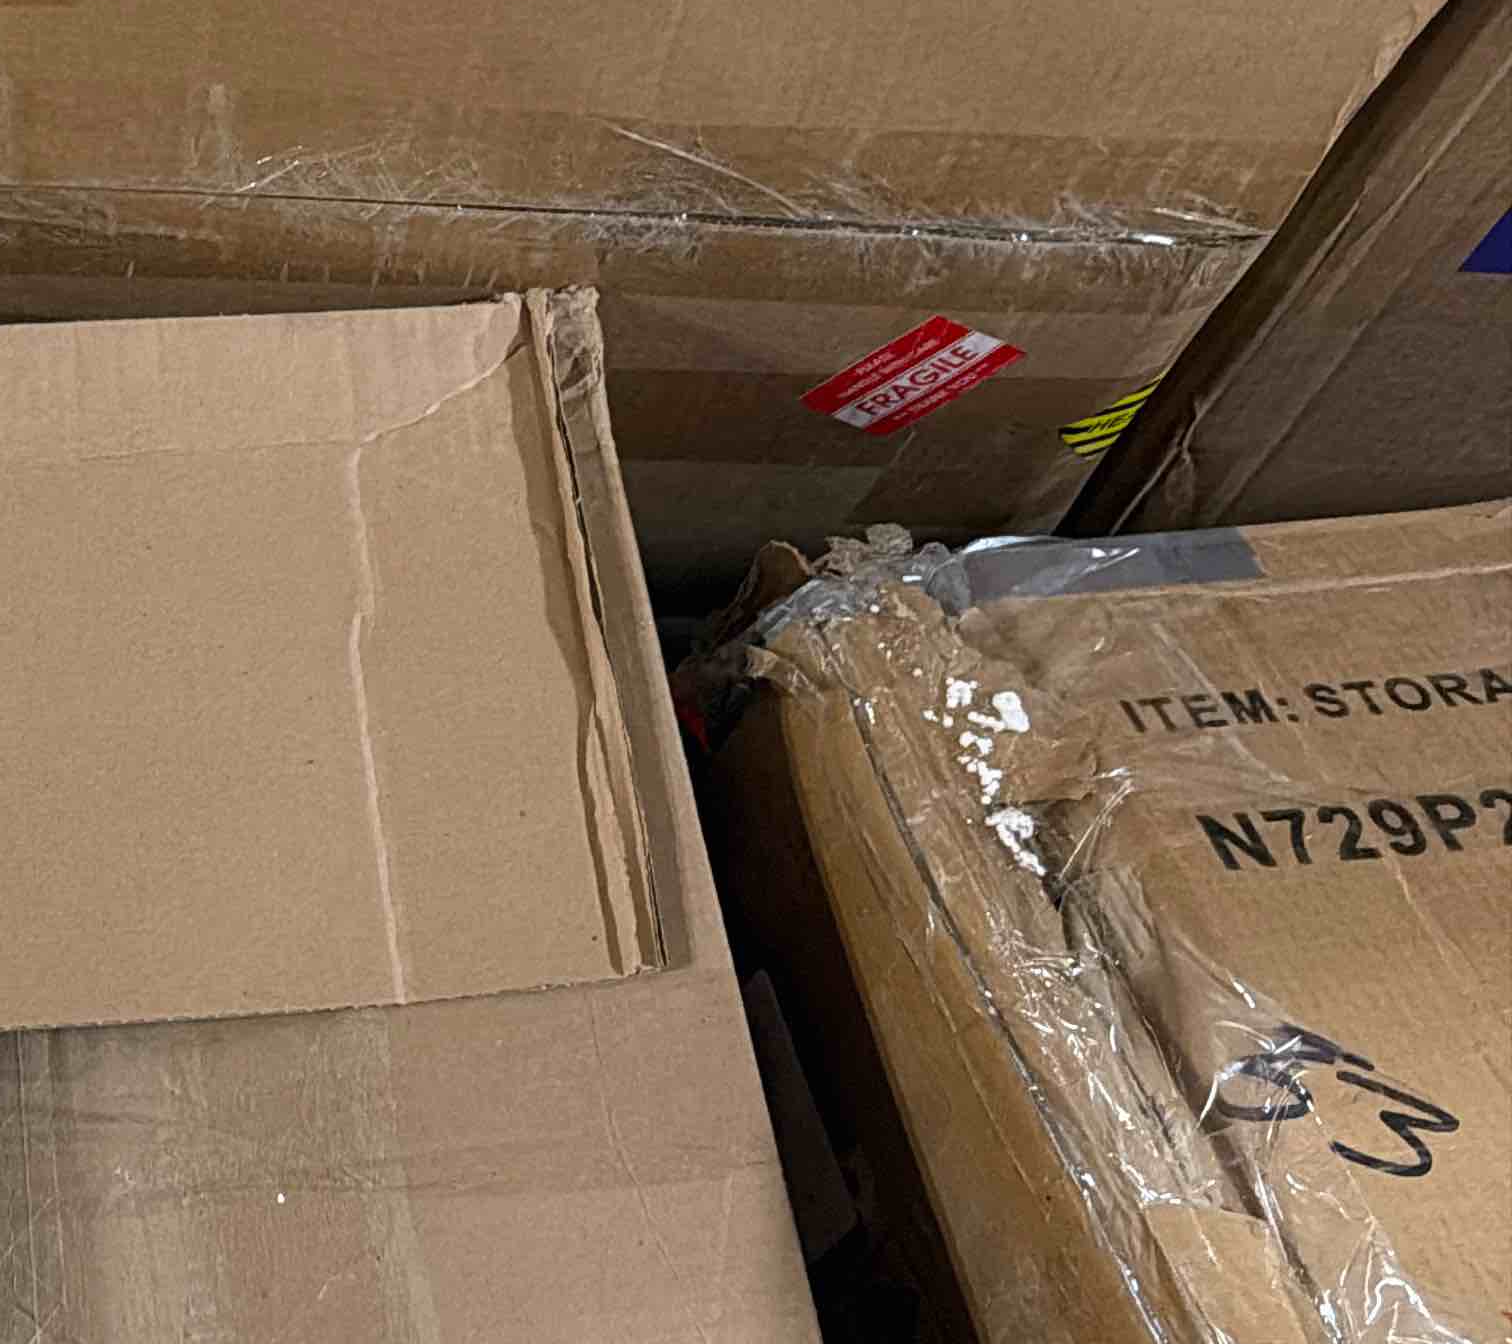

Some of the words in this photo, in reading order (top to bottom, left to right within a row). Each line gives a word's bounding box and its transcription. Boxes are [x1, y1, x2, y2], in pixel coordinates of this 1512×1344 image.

[855, 345, 979, 416] FRAGILE
[1120, 688, 1299, 733] ITEM:
[1196, 789, 1512, 870] N729P2
